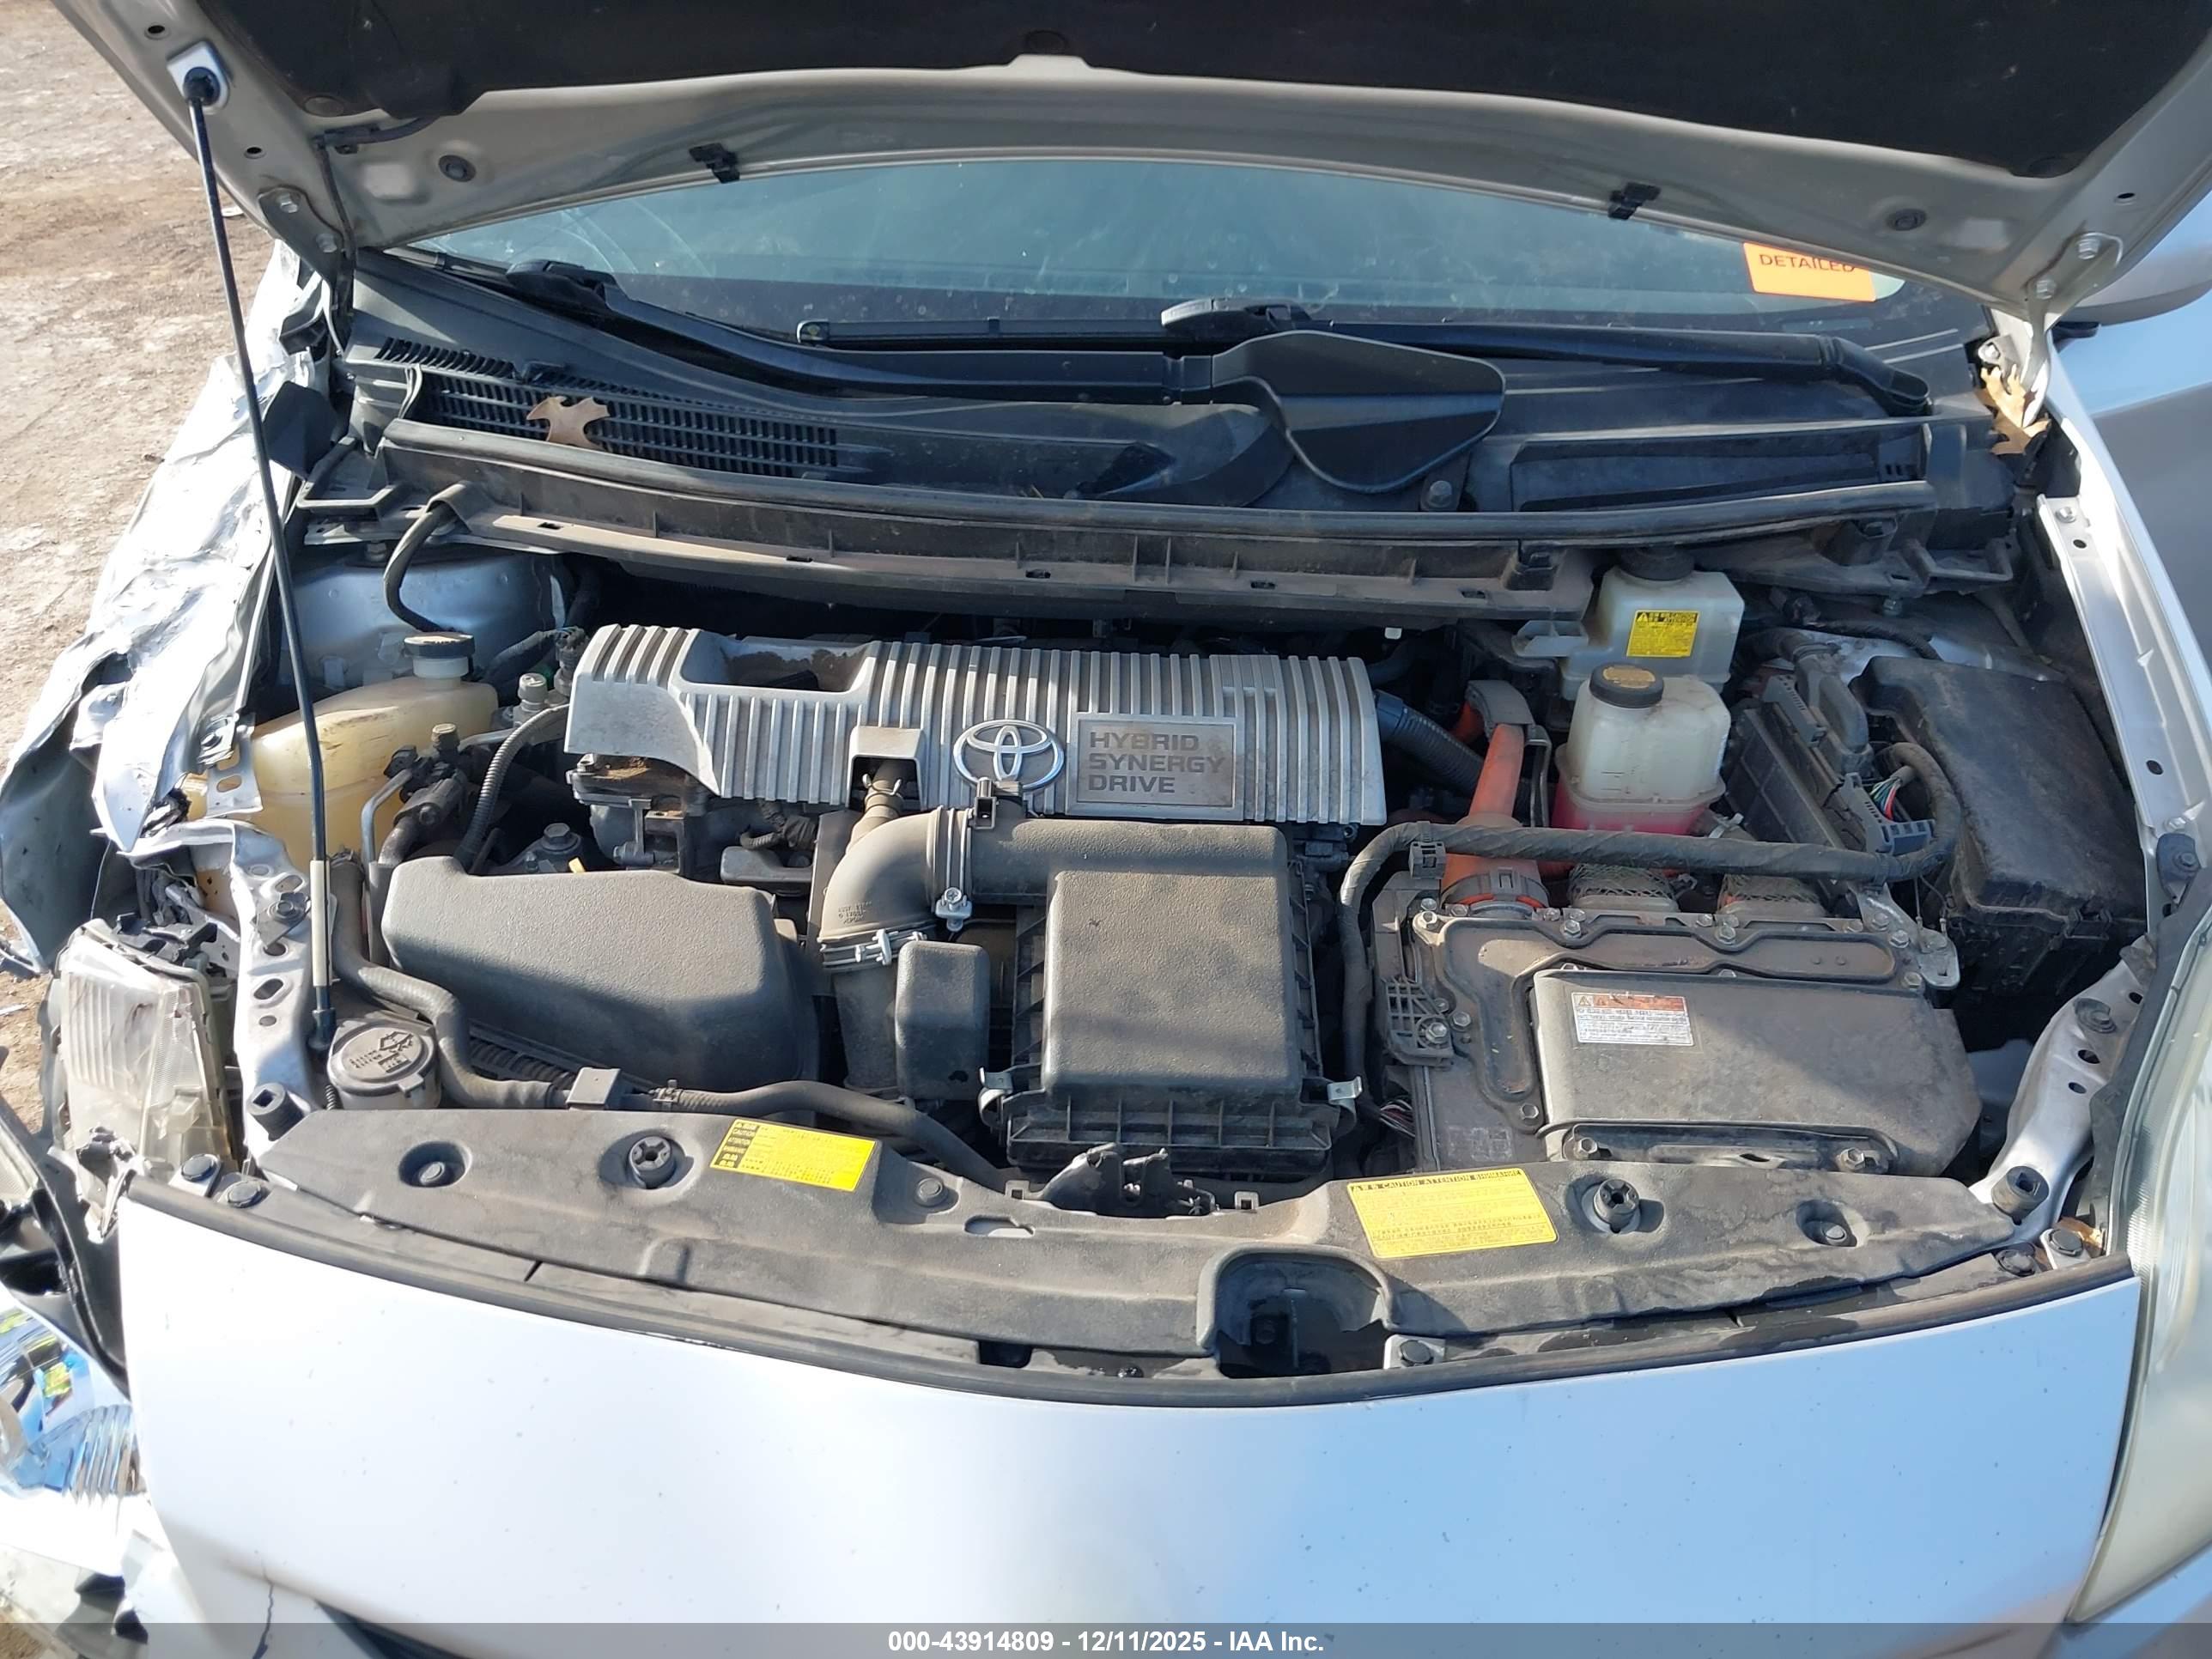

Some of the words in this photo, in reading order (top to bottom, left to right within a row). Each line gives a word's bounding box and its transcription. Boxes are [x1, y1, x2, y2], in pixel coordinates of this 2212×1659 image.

[1090, 732, 1200, 751] HYBRID
[1088, 753, 1225, 774] SYNERGY
[1088, 775, 1176, 793] DRIVE
[1383, 1180, 1419, 1188] CAUTION
[1425, 1175, 1470, 1184] ATTENTION
